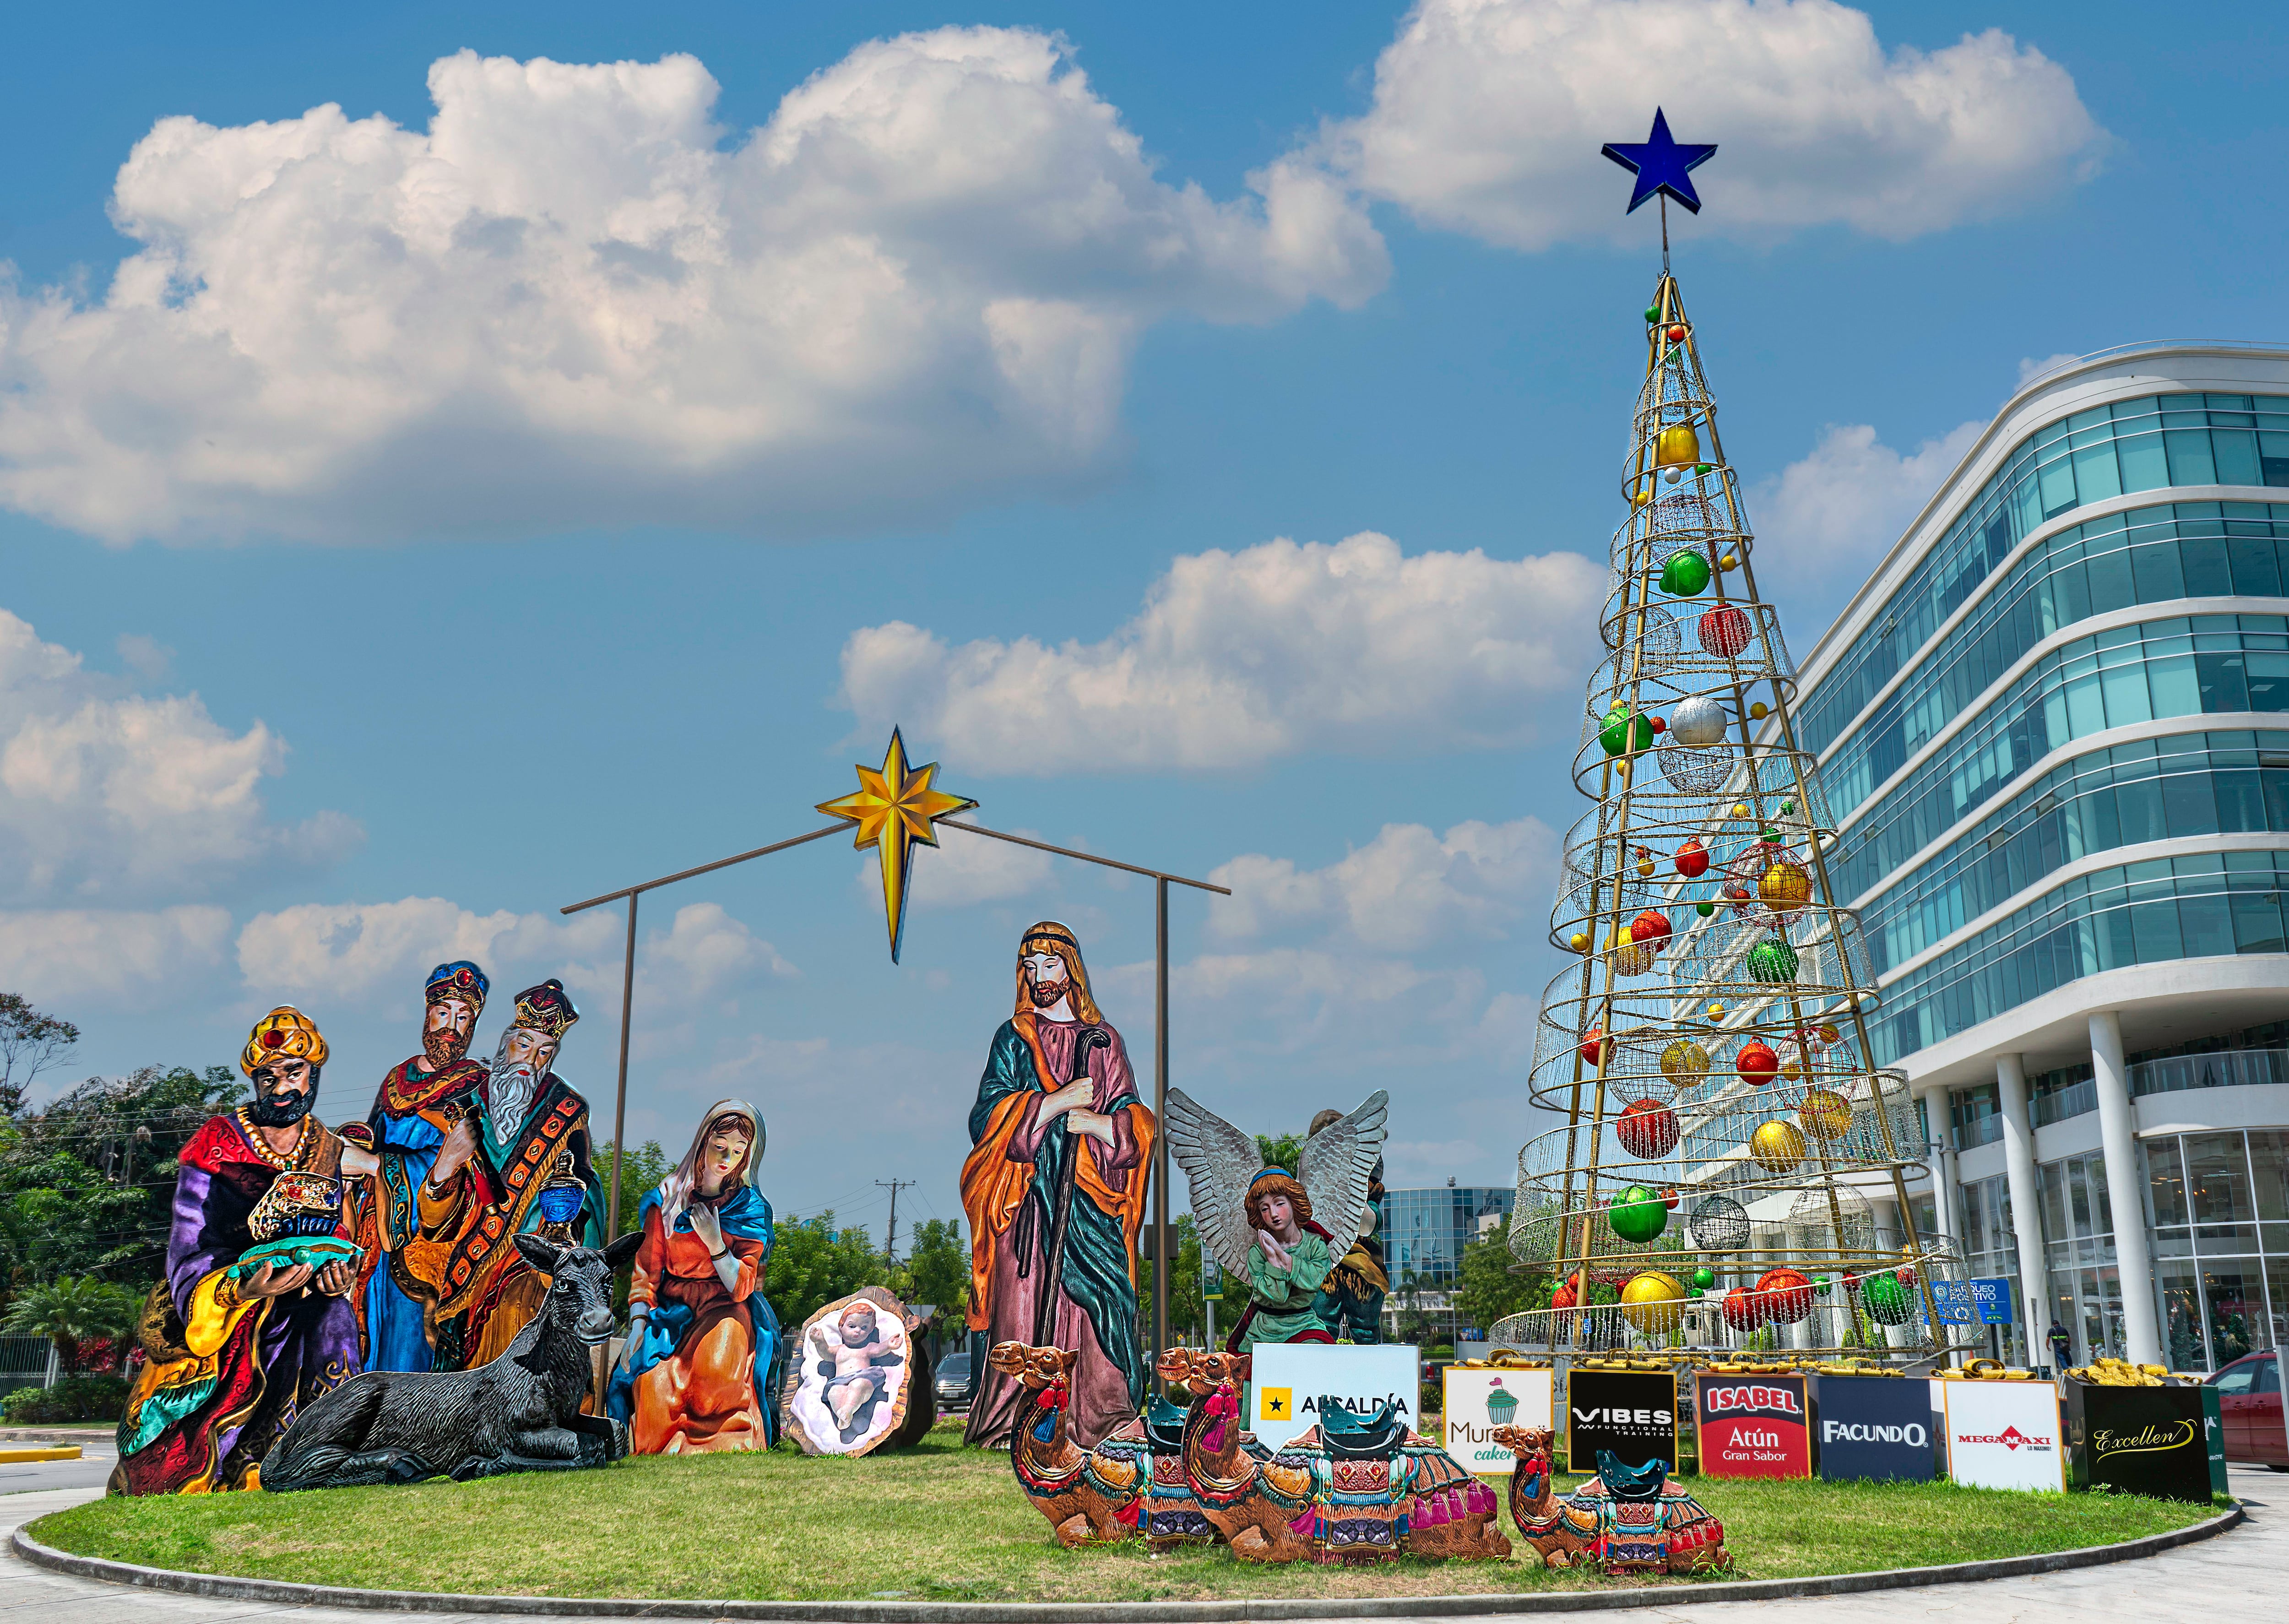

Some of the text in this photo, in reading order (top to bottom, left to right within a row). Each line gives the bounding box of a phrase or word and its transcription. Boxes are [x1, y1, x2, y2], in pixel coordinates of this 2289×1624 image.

[1708, 1386, 1799, 1414] ISABEL
[1572, 1407, 1672, 1424] VIBES
[1729, 1426, 1779, 1447] Atún
[1823, 1420, 1926, 1447] FACUNDO
[1958, 1435, 2051, 1445] MEGAMAXI
[1722, 1450, 1787, 1461] Gran Sabor
